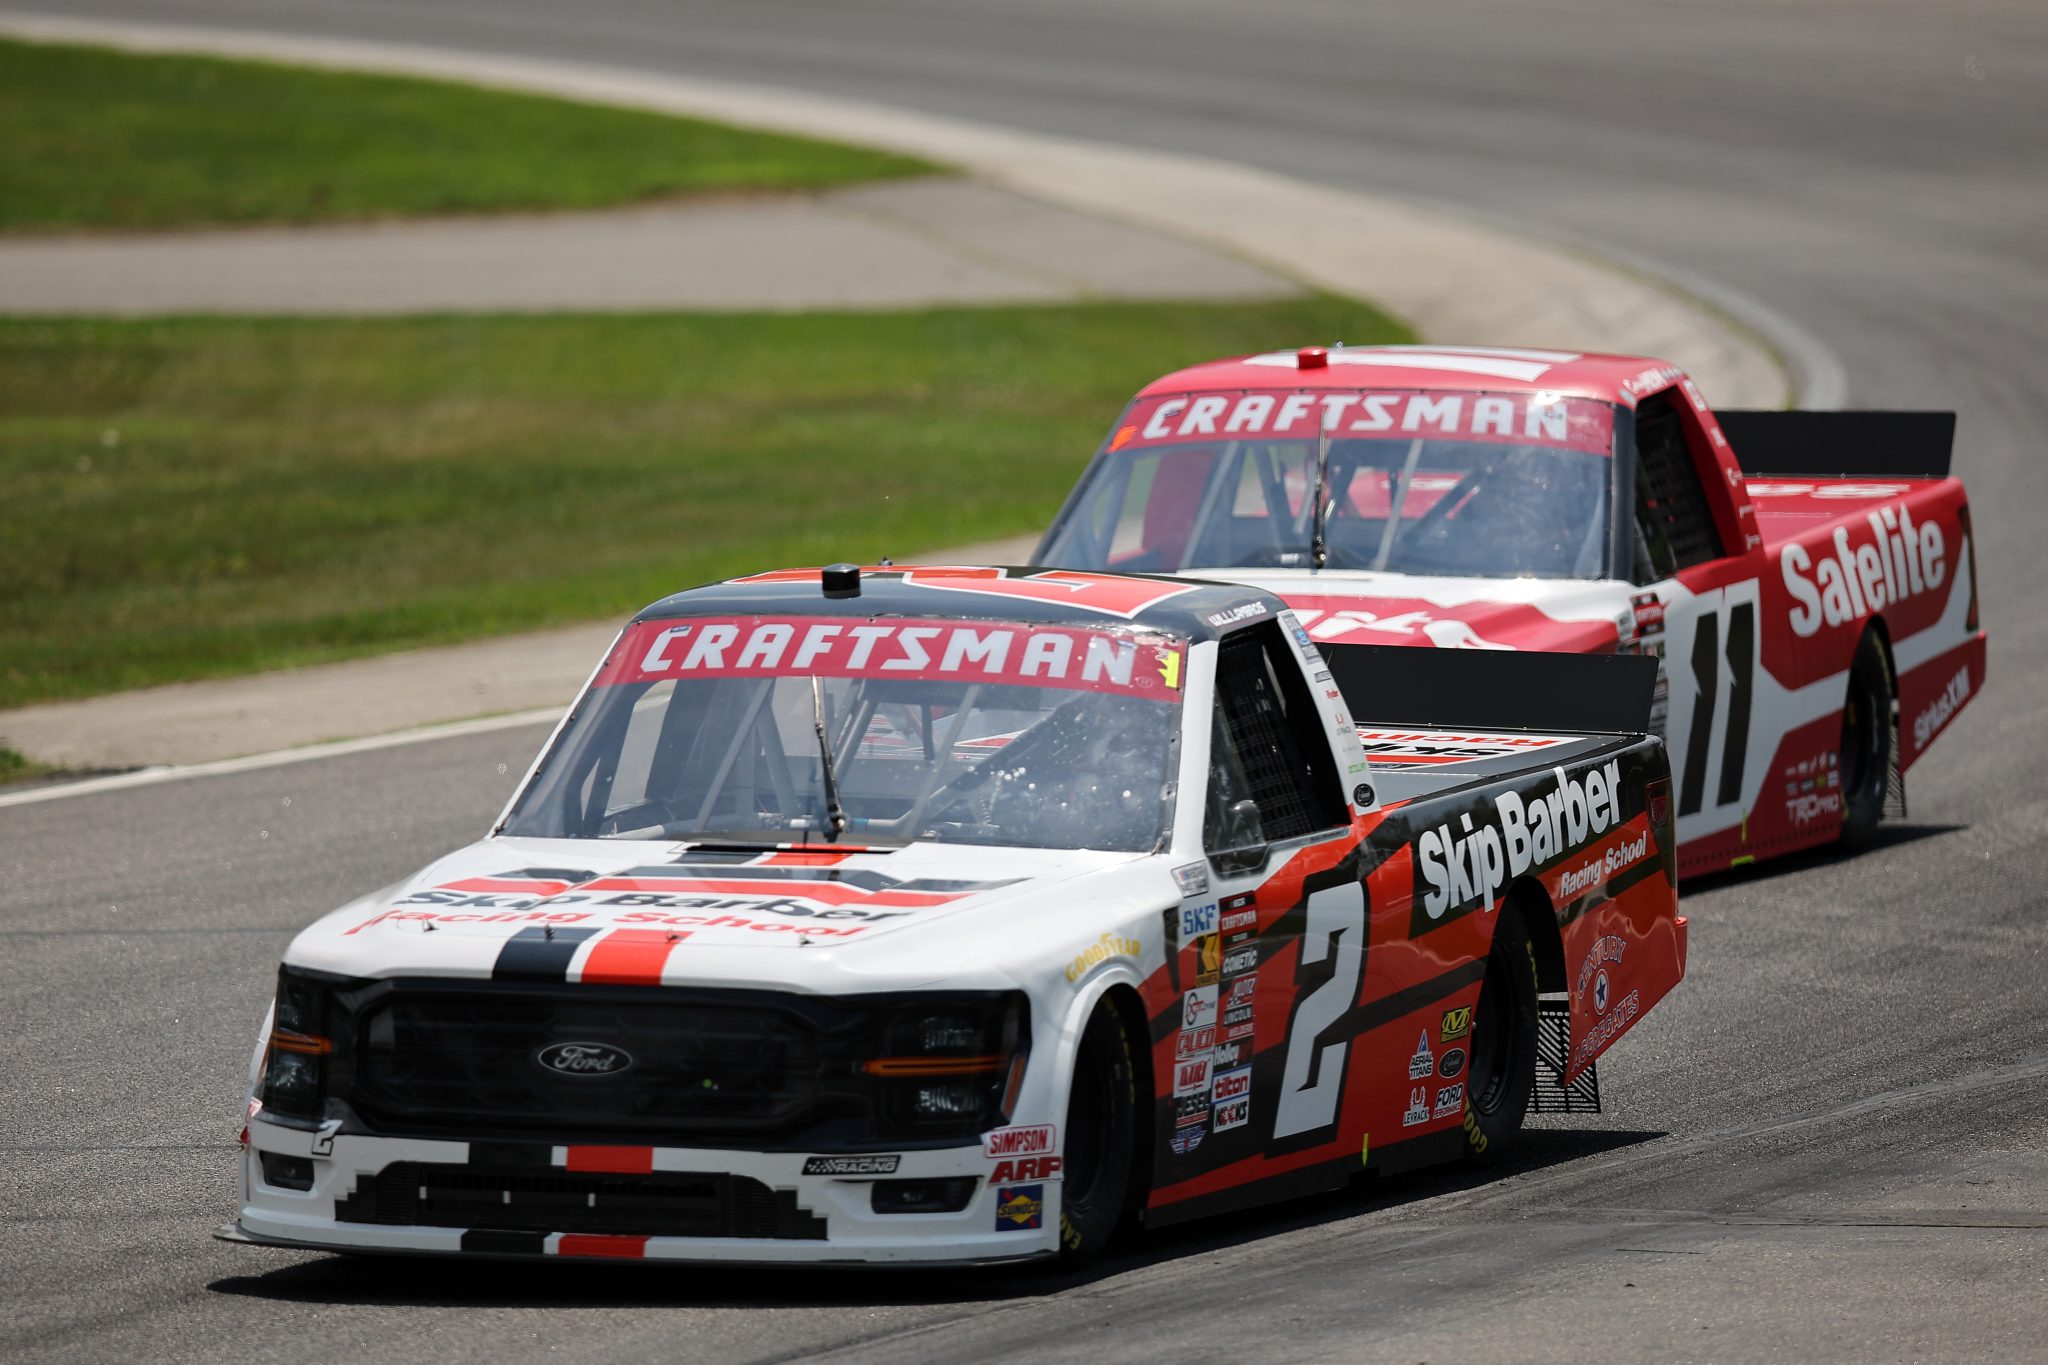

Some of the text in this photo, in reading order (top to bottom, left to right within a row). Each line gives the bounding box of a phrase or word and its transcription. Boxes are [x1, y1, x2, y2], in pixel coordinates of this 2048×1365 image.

[1142, 394, 1568, 442] CRAFTSMAN
[1780, 503, 1946, 637] Safelite
[641, 623, 1138, 685] CRAFTSMAN
[1678, 601, 1754, 818] 11
[1419, 758, 1621, 919] Skip Barber
[1560, 830, 1647, 898] Racing School
[392, 890, 914, 921] Skip Barber
[1183, 903, 1216, 936] SKF
[613, 912, 871, 936] School
[1222, 947, 1258, 974] COMETIC
[1577, 935, 1627, 1000] CENTURY
[1273, 880, 1365, 1140] 2
[1571, 988, 1640, 1073] AGGREGATES
[554, 1045, 617, 1071] Ford
[1214, 1041, 1240, 1067] Holley
[1214, 1075, 1249, 1099] tilton
[1436, 1083, 1464, 1109] FORD
[989, 1128, 1048, 1154] SIMPSON
[836, 1161, 897, 1173] RACING
[988, 1156, 1062, 1184] ARP
